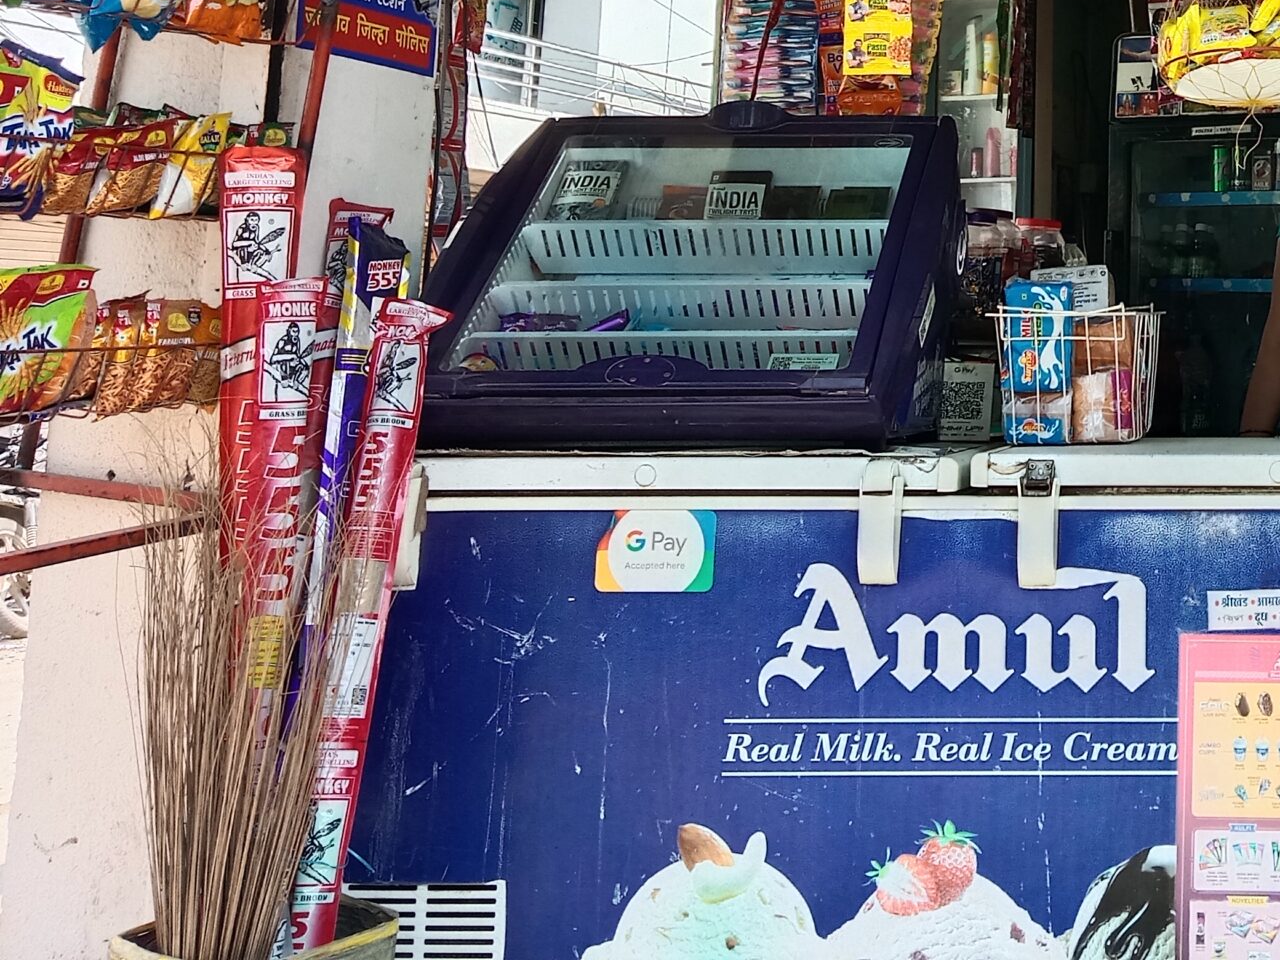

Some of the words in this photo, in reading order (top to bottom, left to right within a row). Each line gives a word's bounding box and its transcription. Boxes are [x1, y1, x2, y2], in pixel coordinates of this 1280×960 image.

[357, 13, 389, 46] जिल्हा
[395, 24, 430, 55] पोलिस
[562, 175, 612, 190] INDIA
[231, 192, 288, 205] MONKEY
[709, 190, 760, 209] INDIA
[369, 262, 400, 271] MONKEY
[367, 272, 400, 291] 555
[268, 302, 317, 317] MONKE
[652, 531, 687, 556] Pay
[624, 560, 664, 573] Accepted
[666, 560, 686, 571] here
[757, 562, 1156, 707] Amul
[722, 734, 802, 763] Real
[810, 731, 902, 763] Milk.
[915, 733, 992, 763] Real
[1001, 734, 1052, 763] Ice
[1063, 733, 1178, 763] Cream
